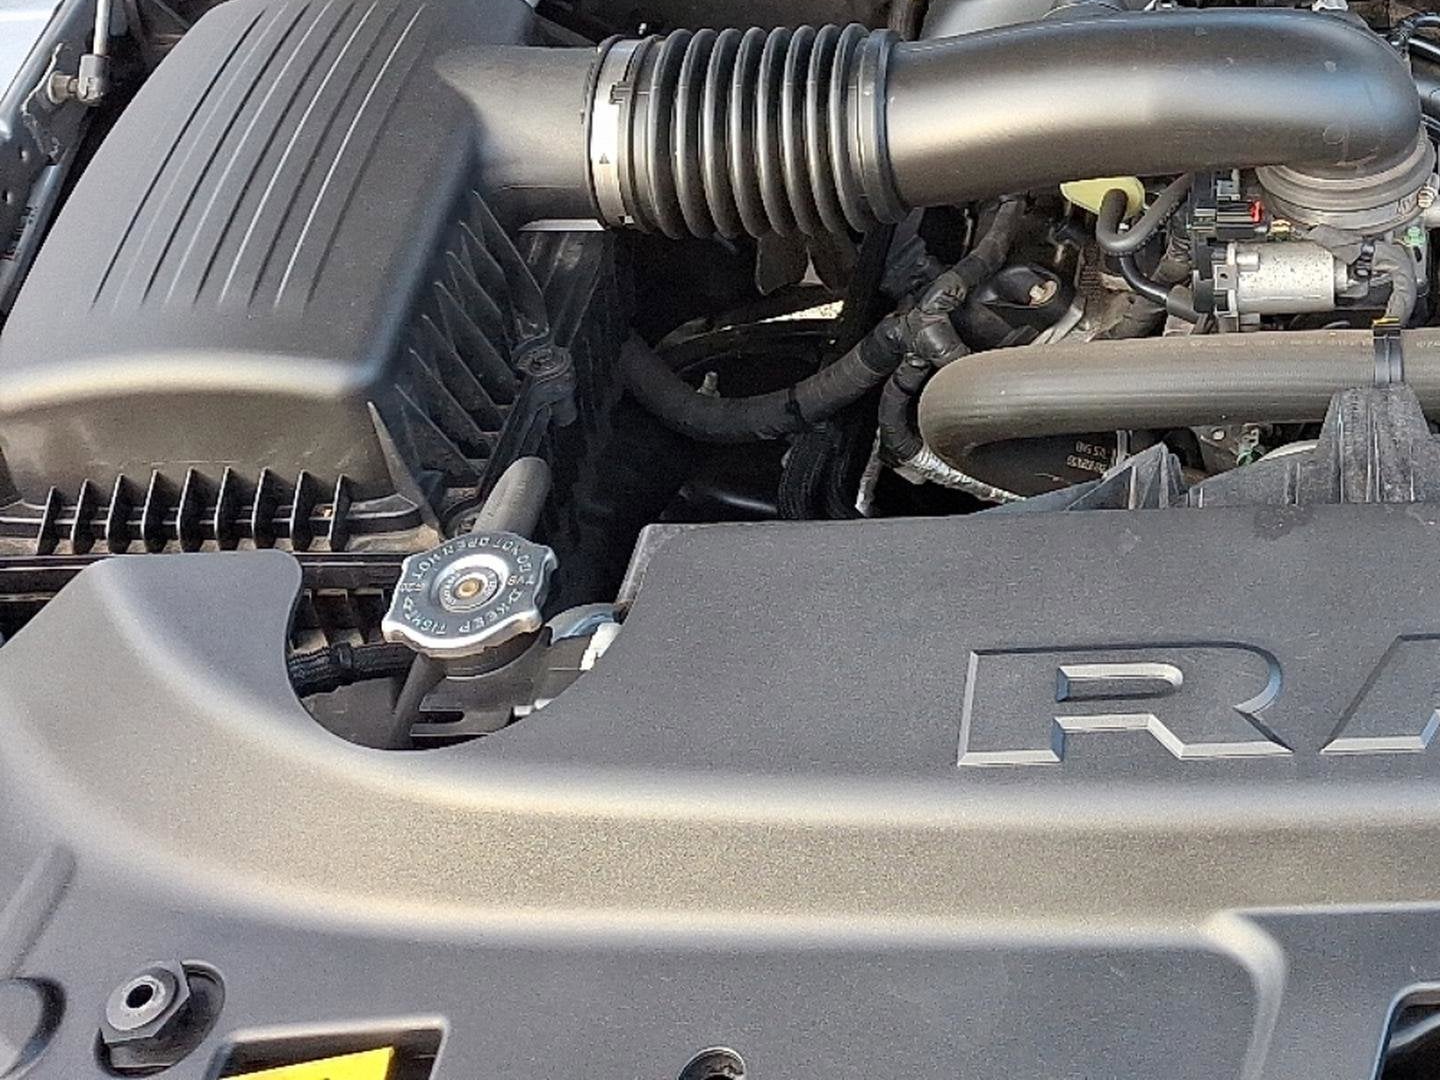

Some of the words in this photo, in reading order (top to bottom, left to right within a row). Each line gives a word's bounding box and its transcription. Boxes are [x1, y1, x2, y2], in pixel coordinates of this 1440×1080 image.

[442, 537, 491, 555] OPEN
[492, 537, 521, 556] NOT
[412, 553, 441, 580] HOT
[517, 554, 532, 573] DO
[458, 602, 511, 633] KEEP
